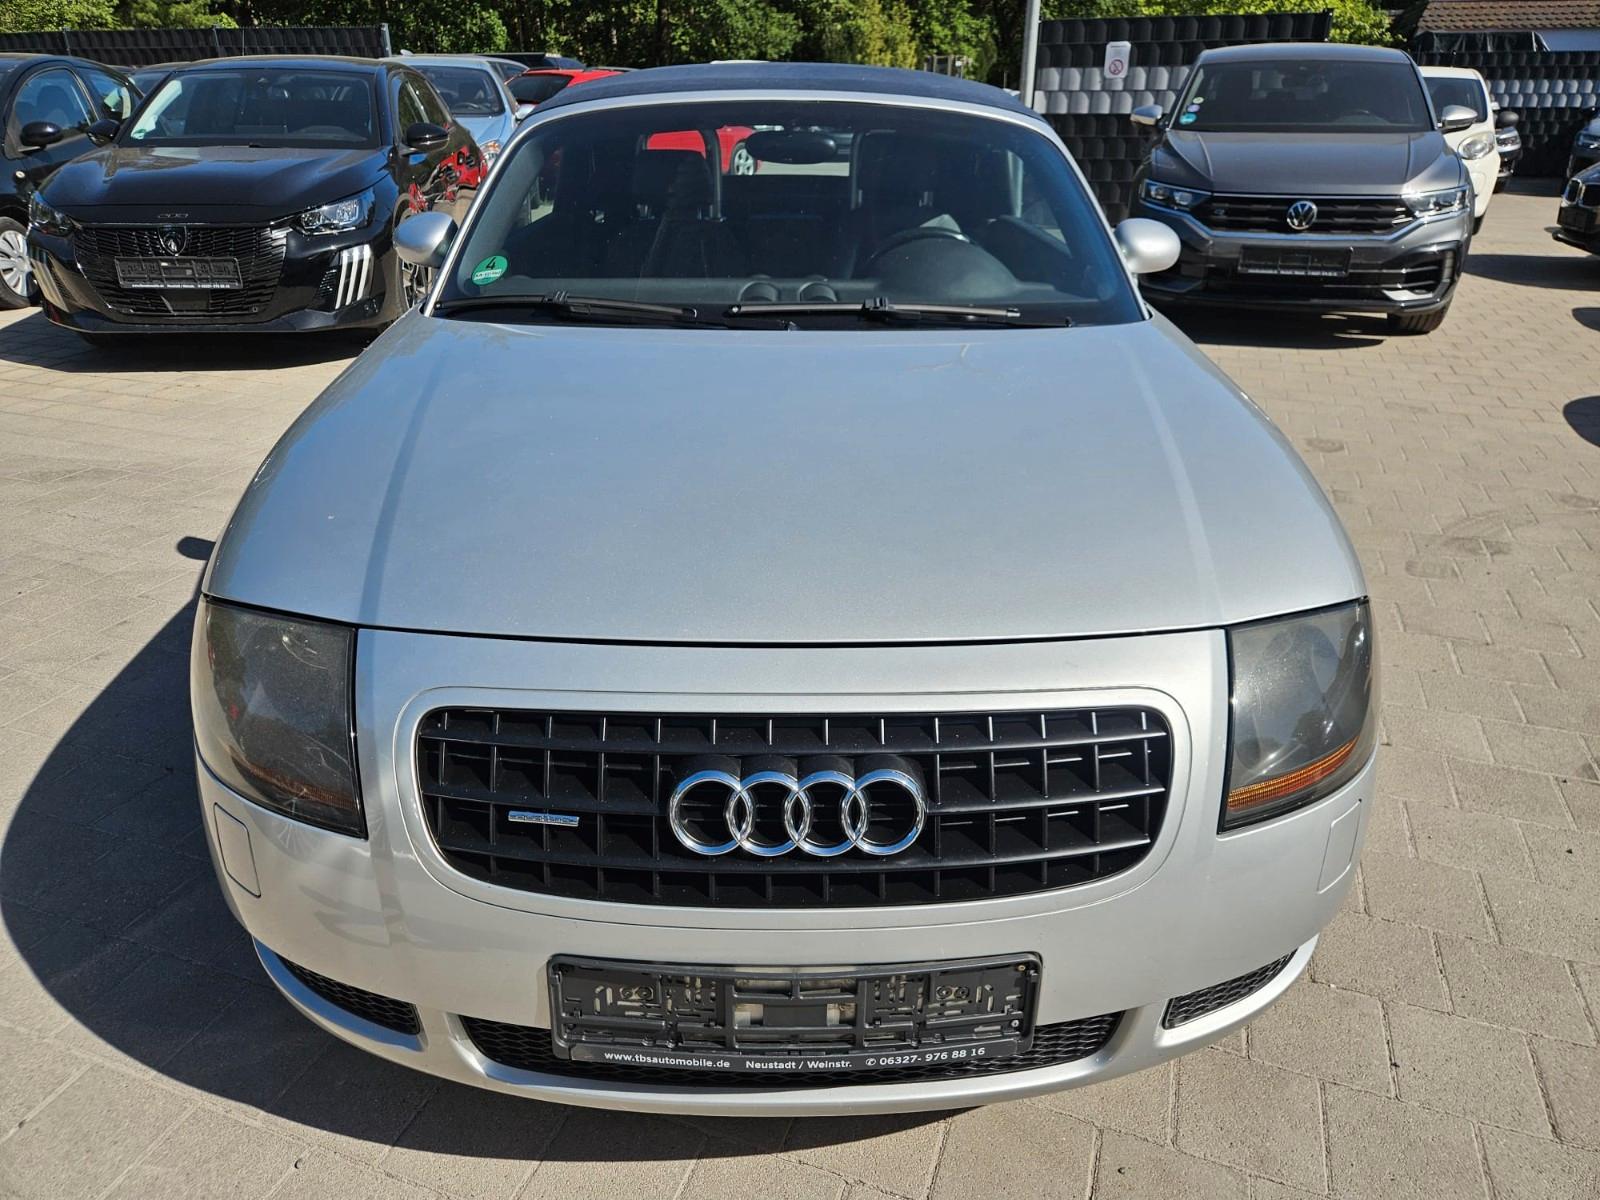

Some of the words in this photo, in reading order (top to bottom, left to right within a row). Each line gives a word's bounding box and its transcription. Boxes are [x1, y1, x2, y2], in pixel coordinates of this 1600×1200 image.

[486, 256, 497, 270] 4
[604, 1052, 731, 1068] www.tbsautomobile.de
[745, 1060, 797, 1069] Neustadt
[807, 1060, 853, 1069] Weinstr.
[879, 1055, 922, 1066] 06327-
[925, 1052, 948, 1062] 976
[951, 1050, 967, 1059] 88
[971, 1047, 986, 1056] 16
